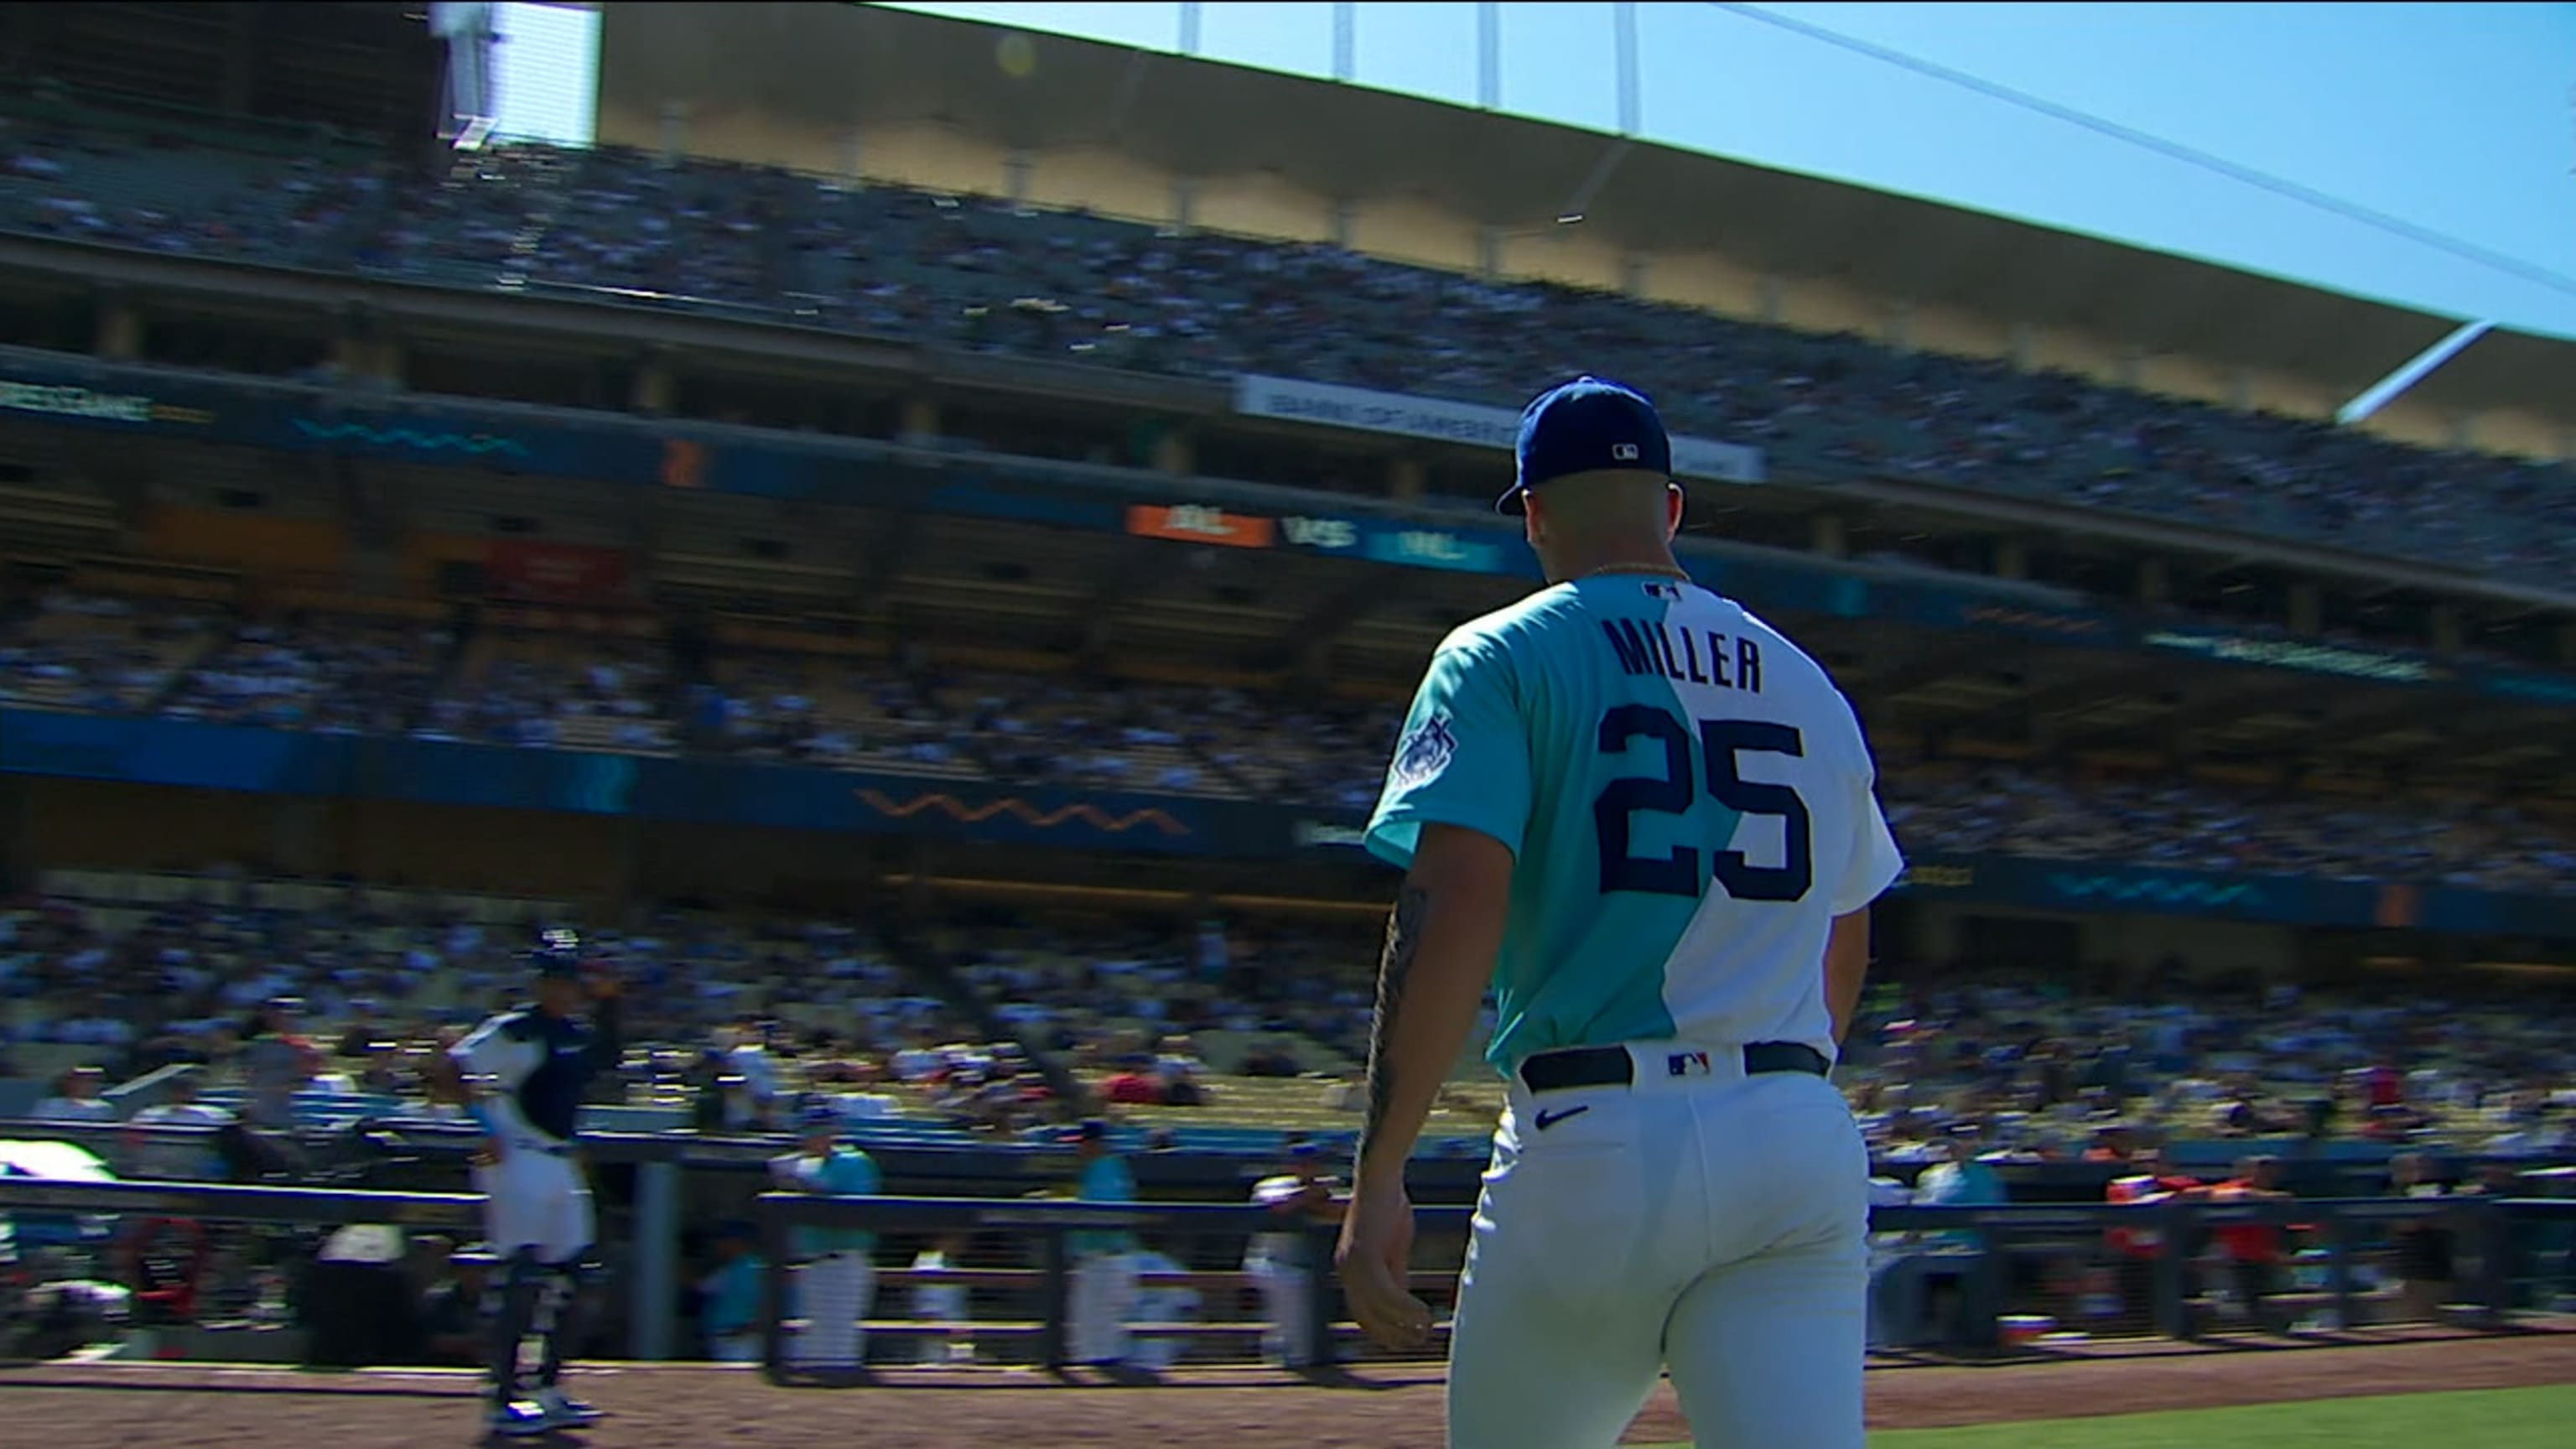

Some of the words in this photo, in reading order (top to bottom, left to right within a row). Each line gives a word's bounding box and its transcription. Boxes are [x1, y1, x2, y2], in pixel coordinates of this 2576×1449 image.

[1280, 516, 1358, 548] VS
[1601, 618, 1760, 693] MILLER
[1594, 704, 1811, 902] 25
